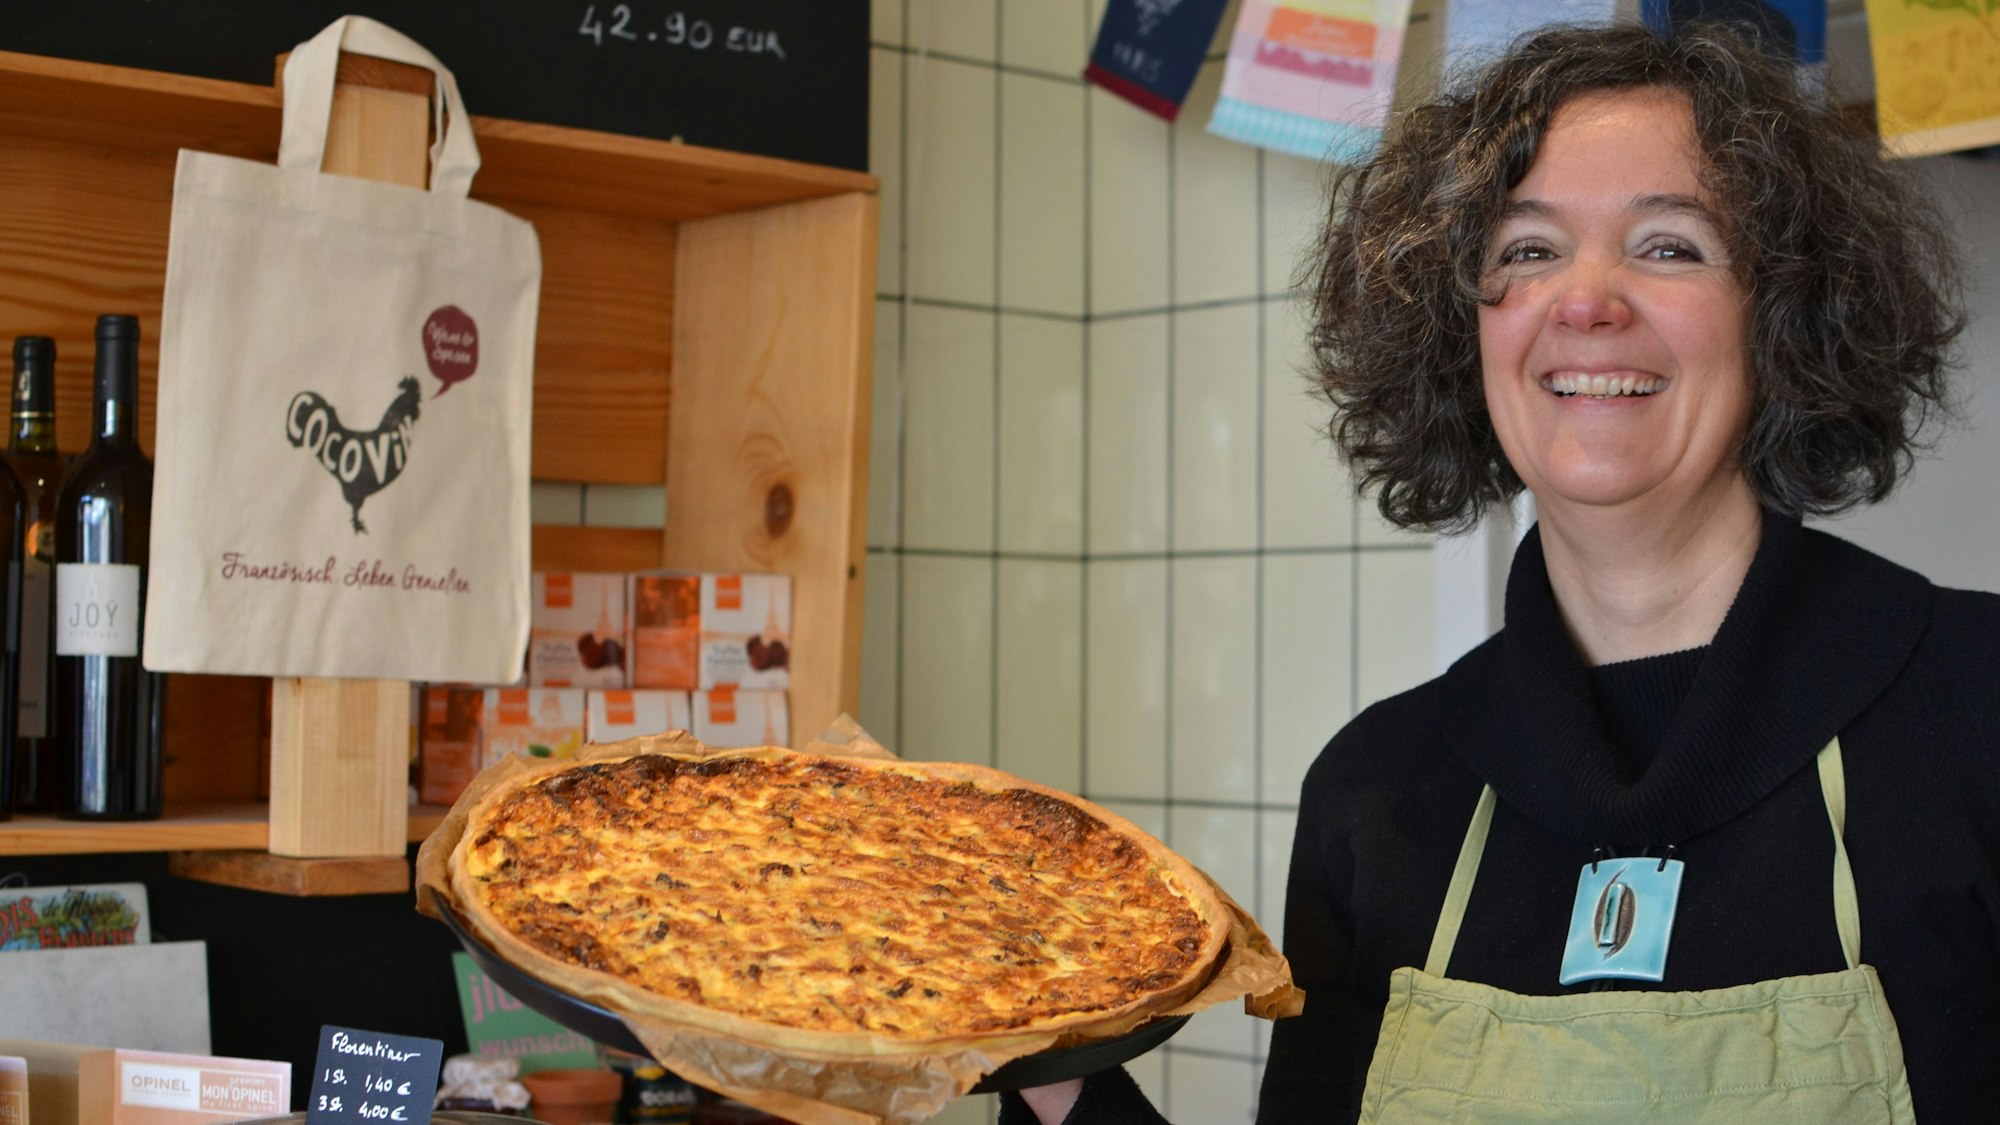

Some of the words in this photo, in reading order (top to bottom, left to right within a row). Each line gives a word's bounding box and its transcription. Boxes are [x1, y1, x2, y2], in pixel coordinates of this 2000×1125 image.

[577, 4, 714, 50] 42.90
[726, 26, 786, 59] EUR
[69, 602, 119, 629] JOY
[331, 1032, 421, 1062] Florentiner
[131, 1074, 191, 1093] OPINEL
[202, 1085, 229, 1101] MON
[232, 1087, 276, 1105] OPINEL
[365, 1074, 393, 1093] 1,40
[397, 1081, 411, 1095] €
[318, 1095, 328, 1111] 3
[358, 1101, 388, 1119] 4,00
[390, 1106, 408, 1122] €
